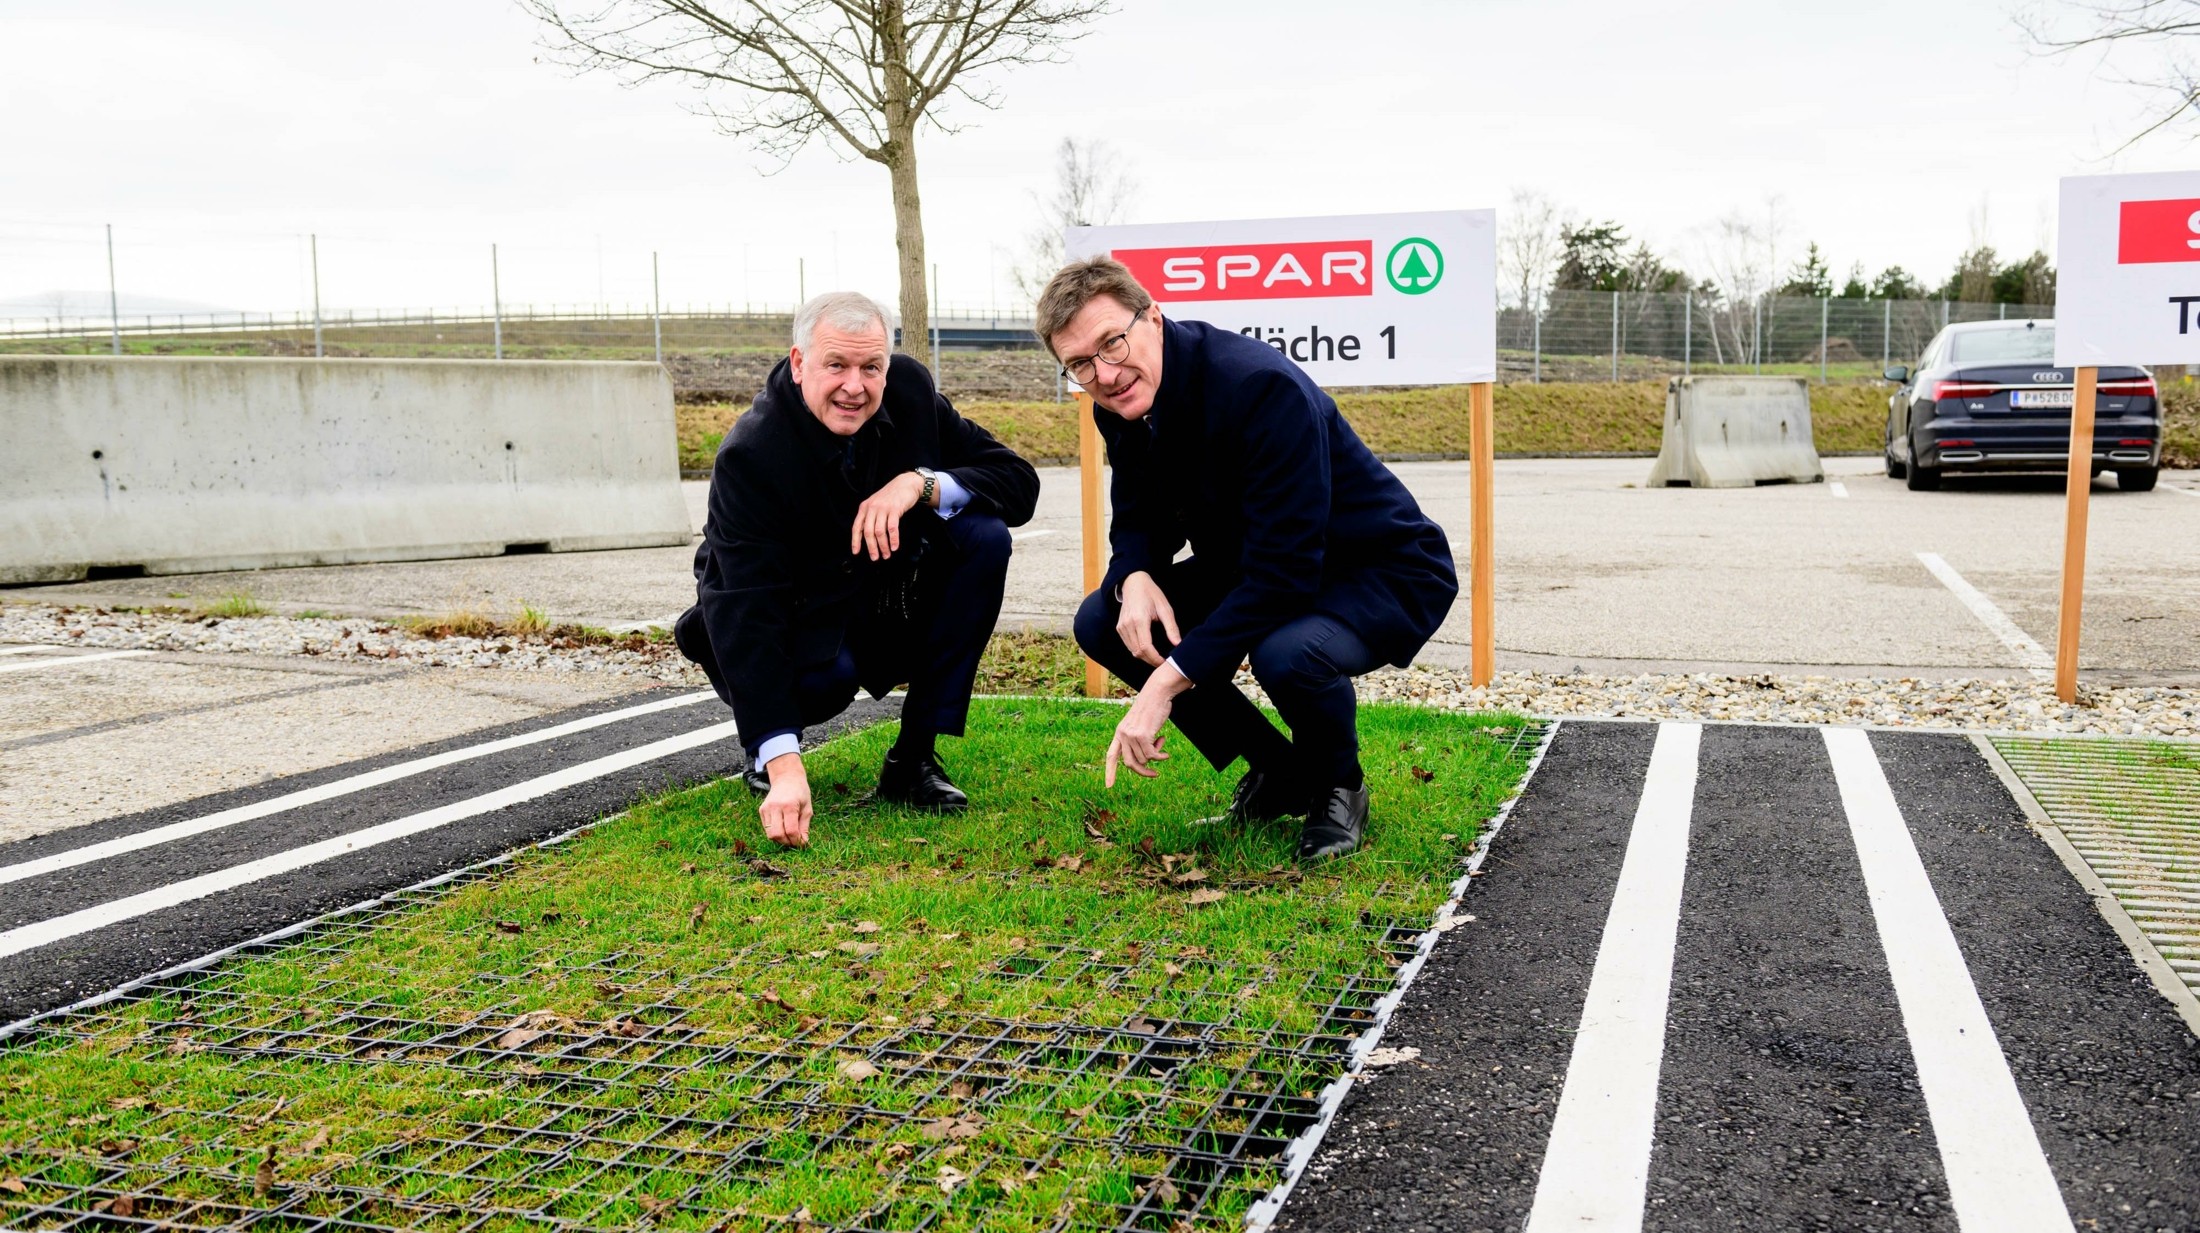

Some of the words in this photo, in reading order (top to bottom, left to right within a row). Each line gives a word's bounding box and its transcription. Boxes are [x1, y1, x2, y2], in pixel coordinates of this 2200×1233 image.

[1163, 250, 1366, 292] SPAR
[2168, 295, 2200, 335] T
[1239, 325, 1361, 362] äche
[1379, 325, 1396, 360] 1
